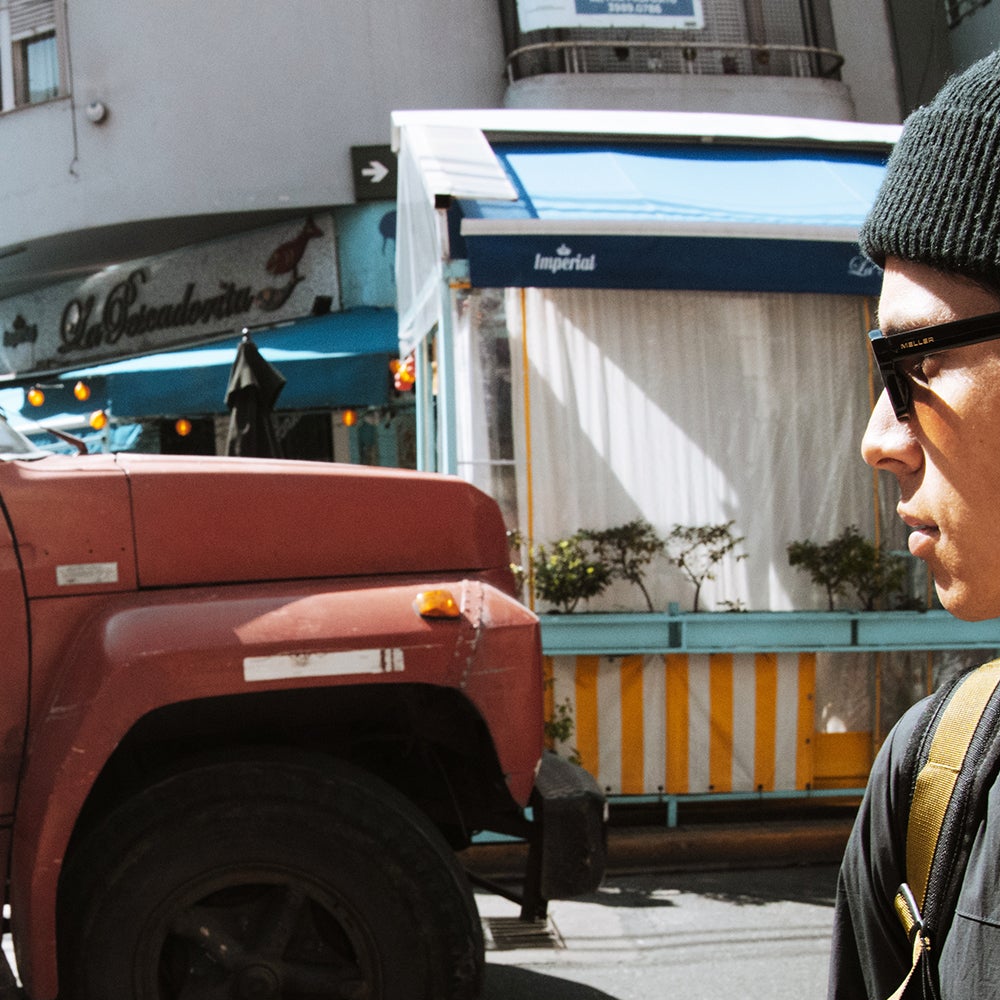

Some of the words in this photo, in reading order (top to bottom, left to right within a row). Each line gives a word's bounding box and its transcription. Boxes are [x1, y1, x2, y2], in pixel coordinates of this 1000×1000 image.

[534, 253, 596, 274] Imperial
[57, 294, 103, 353] La
[102, 267, 253, 345] Pescadorita
[900, 336, 935, 350] MELLER
